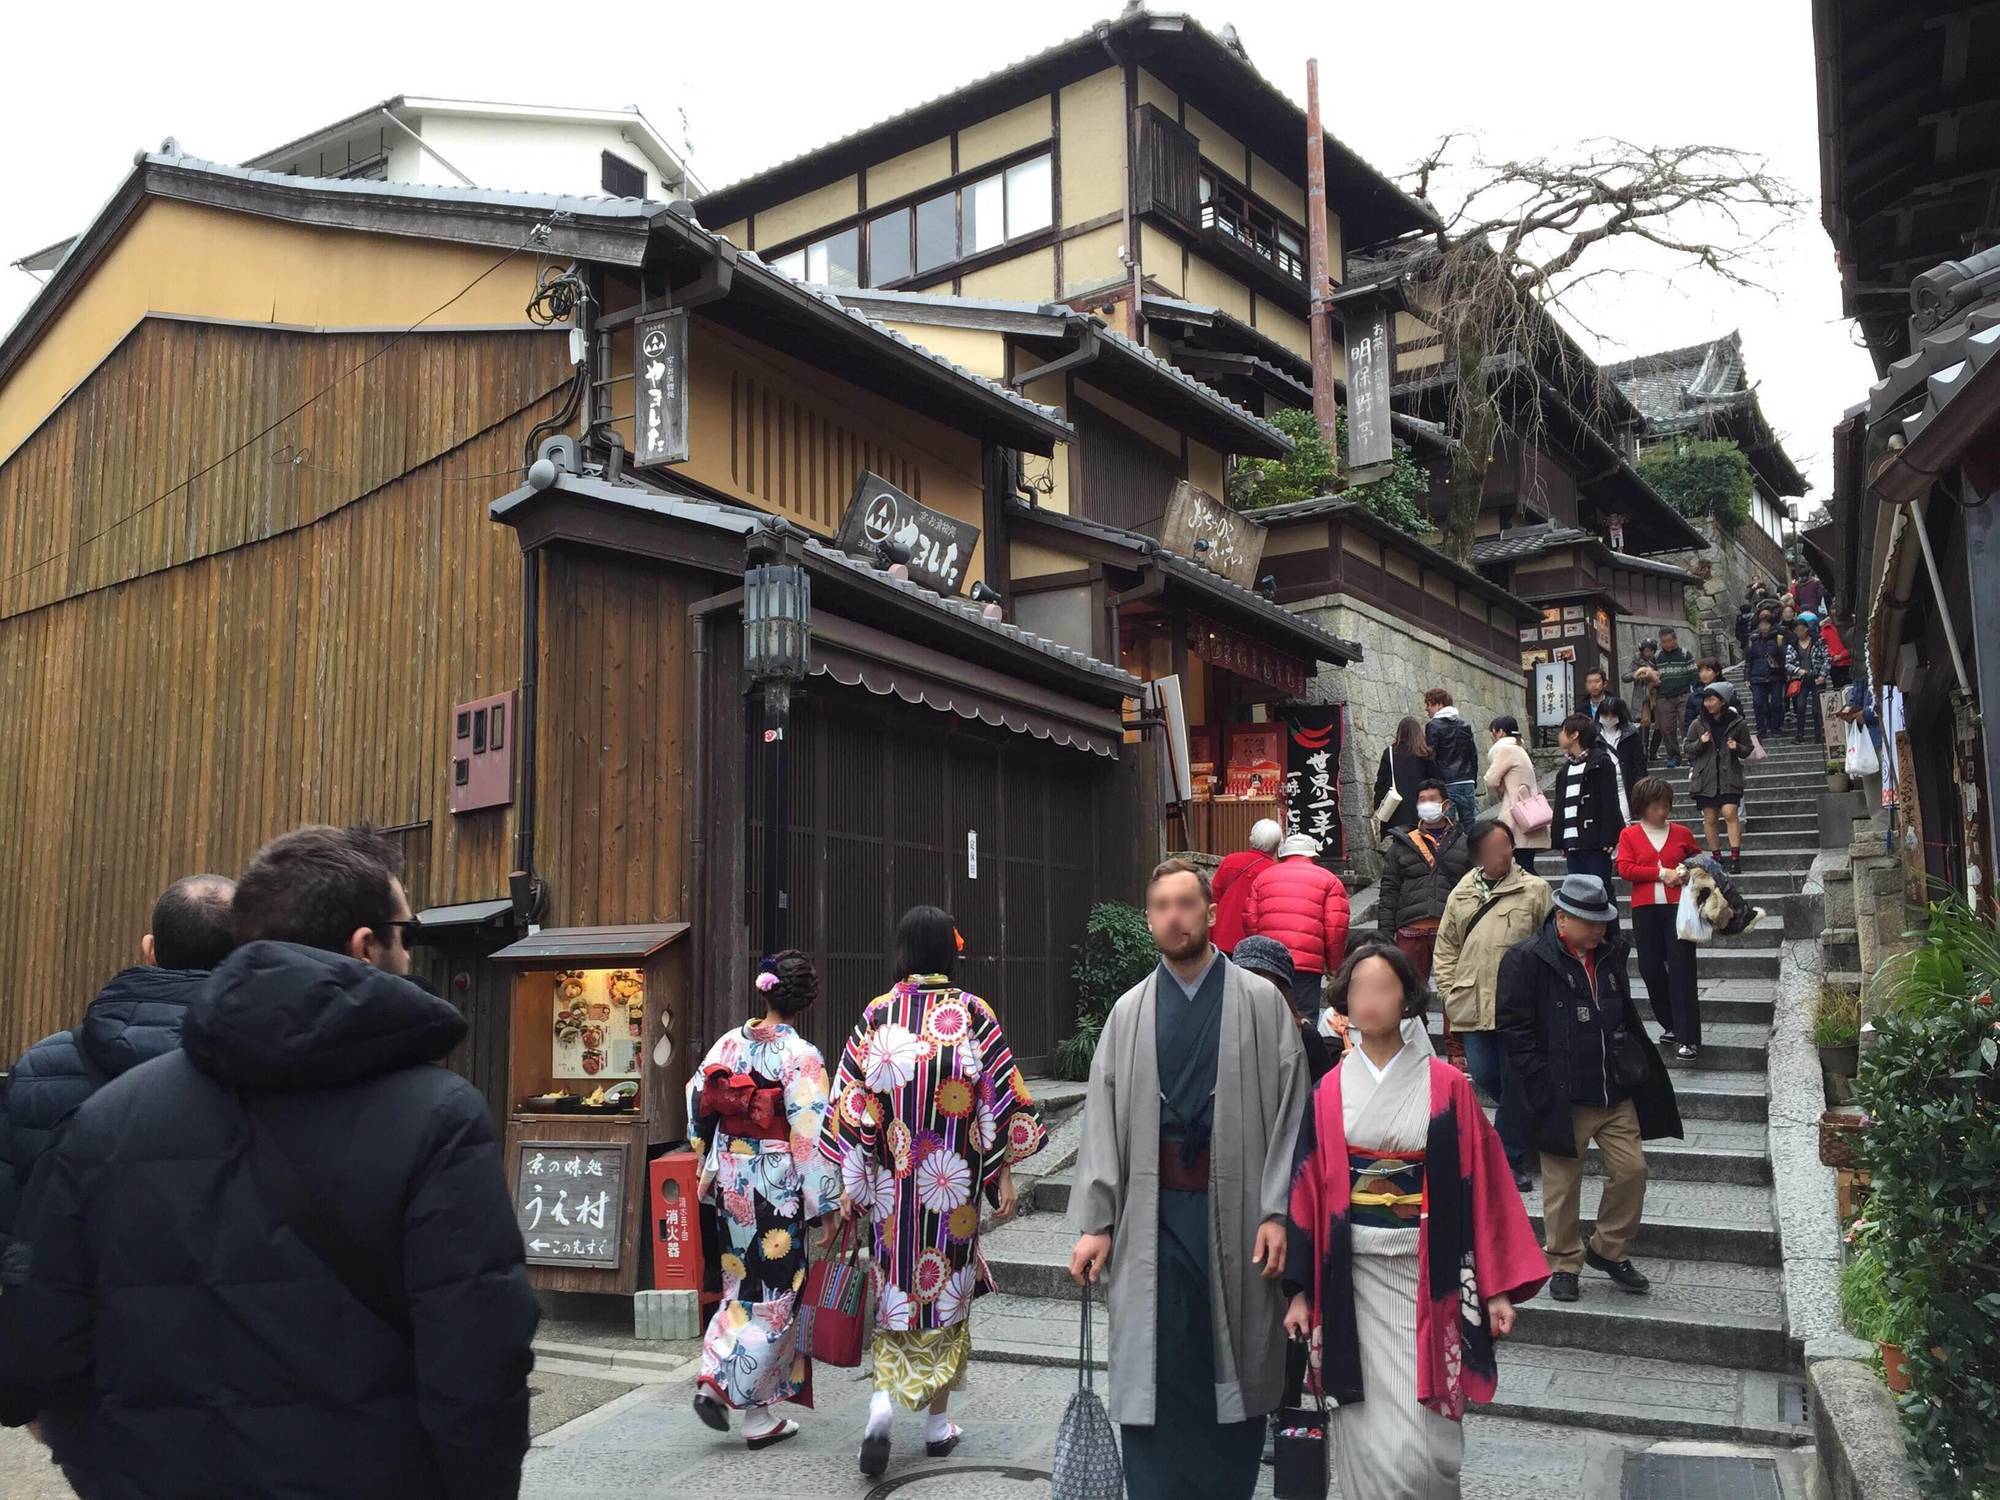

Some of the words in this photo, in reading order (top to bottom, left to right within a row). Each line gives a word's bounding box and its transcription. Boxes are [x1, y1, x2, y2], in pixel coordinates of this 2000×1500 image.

[1351, 337, 1374, 448] 明保野亭
[527, 1152, 603, 1178] 京の味処
[524, 1184, 610, 1230] うえ村
[553, 1239, 608, 1255] この先すぐ
[666, 1209, 680, 1258] 消火器
